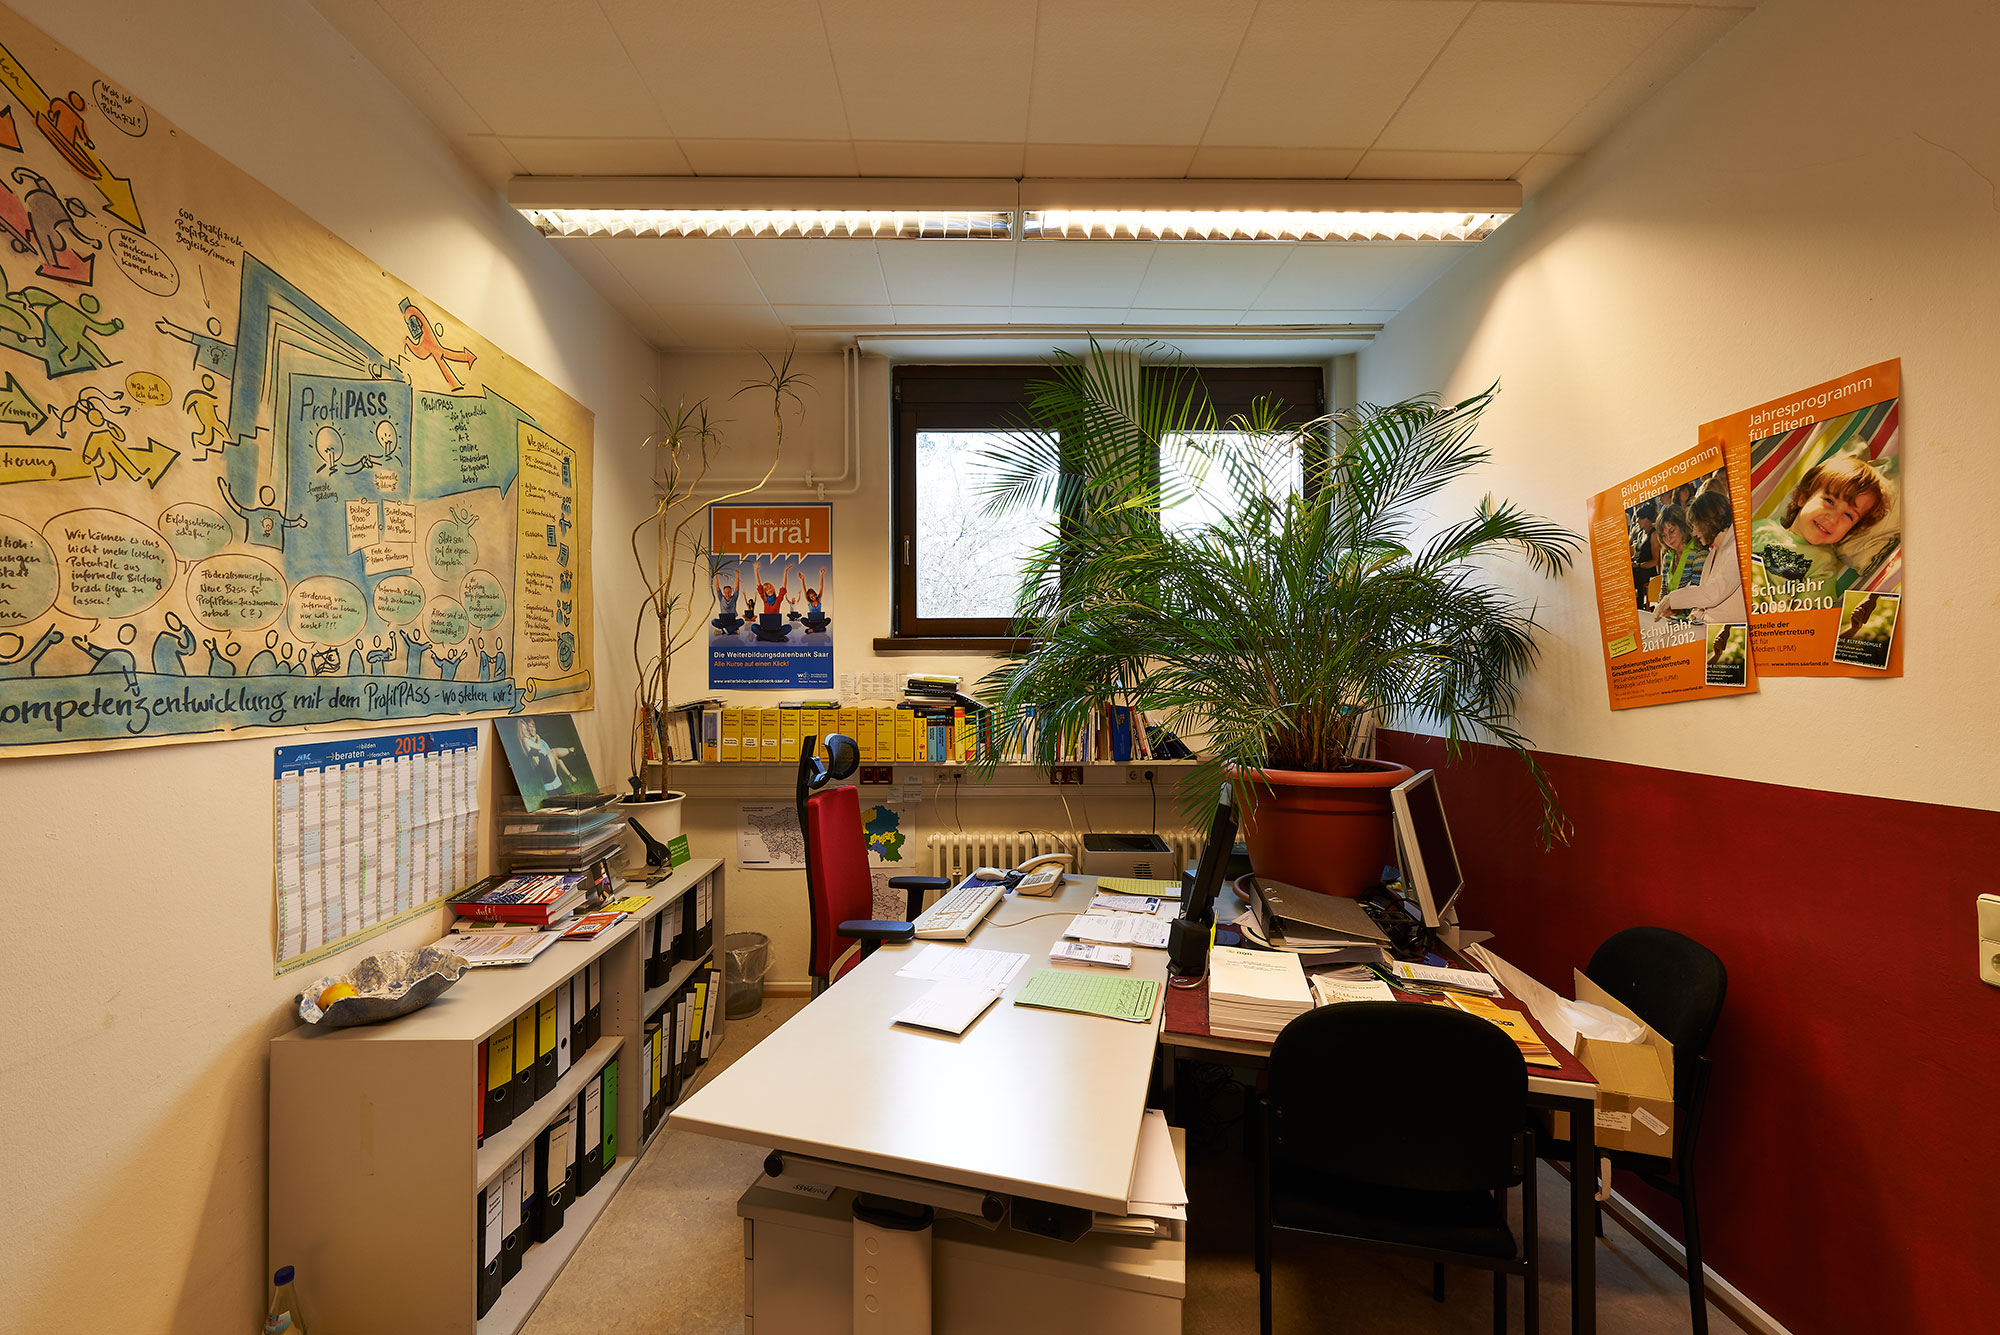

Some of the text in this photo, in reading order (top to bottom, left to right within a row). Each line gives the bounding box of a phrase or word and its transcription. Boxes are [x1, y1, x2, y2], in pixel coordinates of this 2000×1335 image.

[178, 208, 194, 222] 600
[300, 387, 388, 421] ProfilPASS
[1748, 376, 1873, 428] Jahresprogramm
[1748, 413, 1815, 442] für Eltern
[0, 452, 57, 477] tierung
[1621, 444, 1719, 498] Bildungsprogramm
[1622, 484, 1669, 510] für Eltern
[731, 518, 810, 544] Hurra!
[780, 518, 801, 526] Klick
[1751, 578, 1825, 599] Schuljahr
[1750, 595, 1834, 615] 2009/2010
[1641, 619, 1693, 640] Schuljahr
[1641, 631, 1696, 653] 2011/2012
[726, 651, 811, 659] Weiterbildungsdatenbank
[0, 686, 288, 735] ompetenzentwicklung
[293, 687, 322, 709] mit
[328, 689, 361, 709] dem
[364, 682, 431, 716] ProfilPASS
[458, 682, 488, 701] stehen
[334, 750, 365, 761] beraten
[394, 735, 425, 755] 2013
